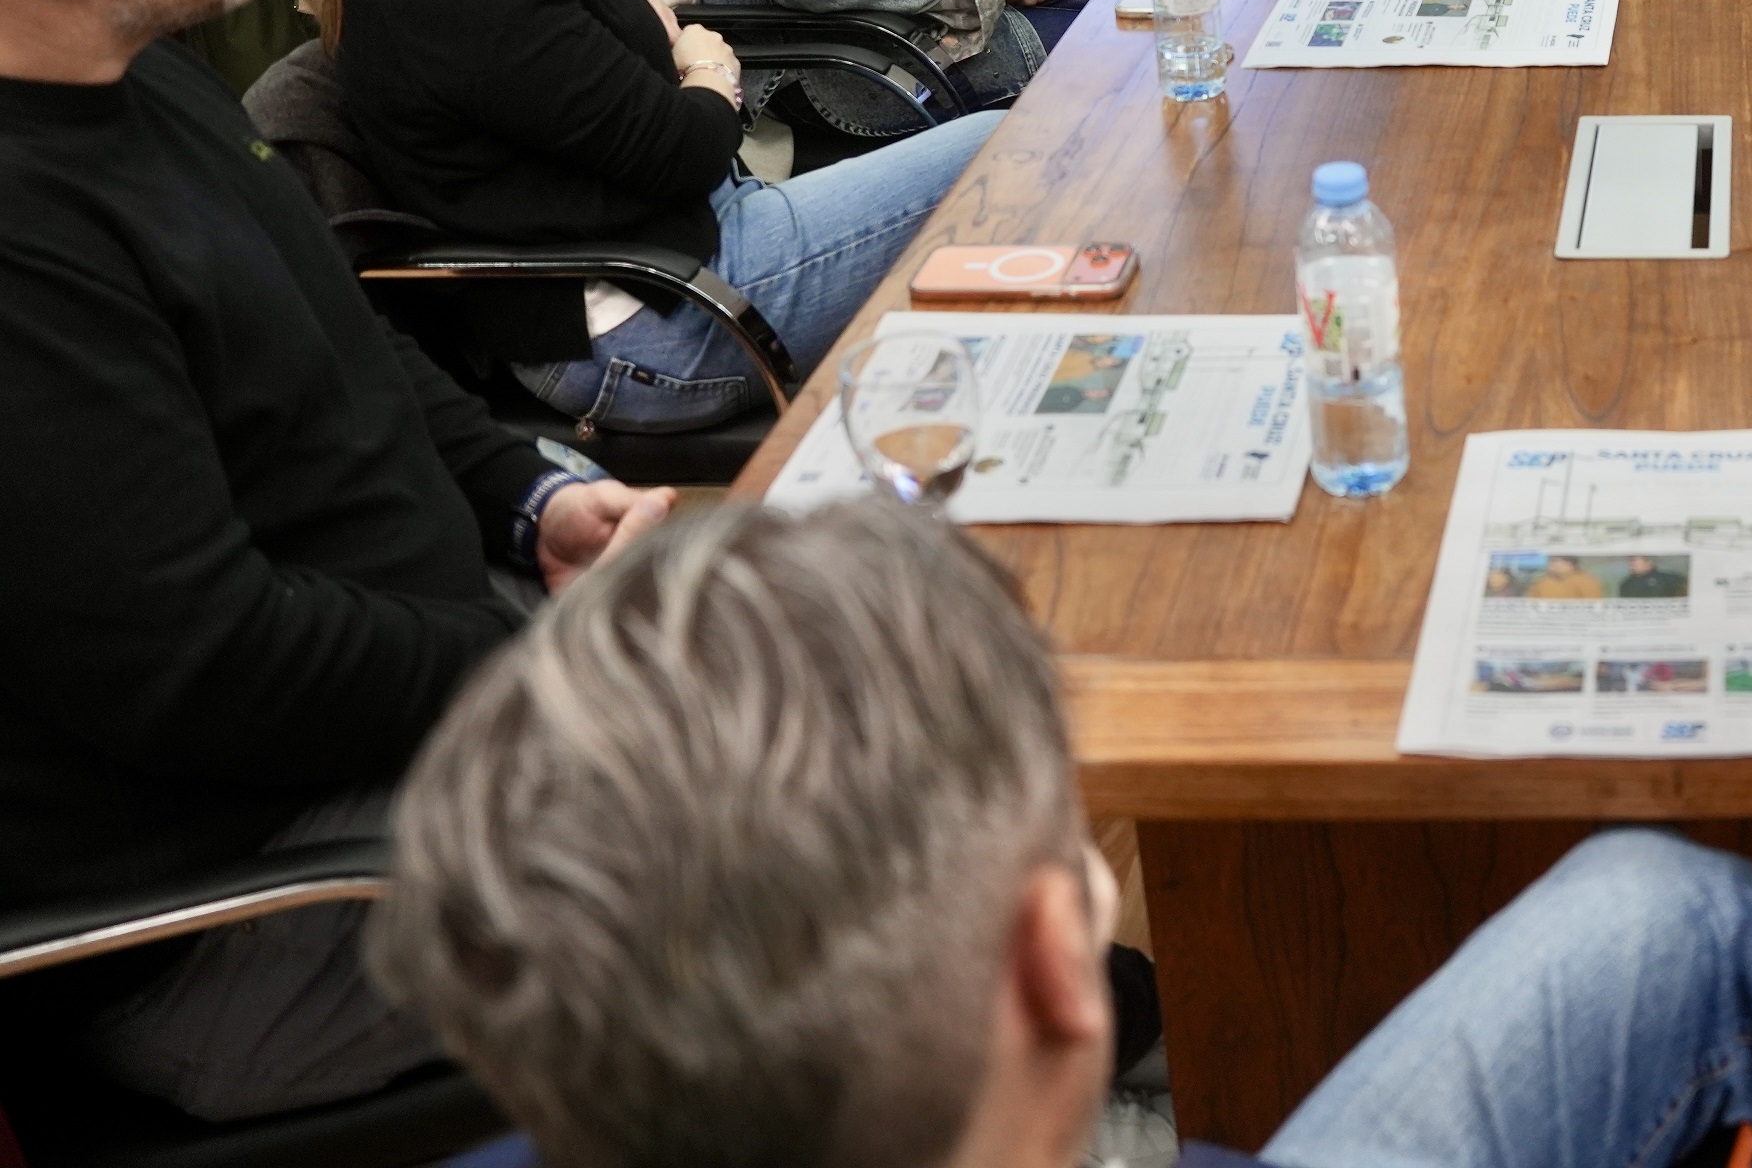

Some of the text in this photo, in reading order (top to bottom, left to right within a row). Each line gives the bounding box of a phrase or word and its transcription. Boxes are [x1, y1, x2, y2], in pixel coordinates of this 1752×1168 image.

[1565, 3, 1580, 23] PUEDE
[1579, 15, 1592, 31] CRUZ
[1598, 449, 1682, 461] SANTA
